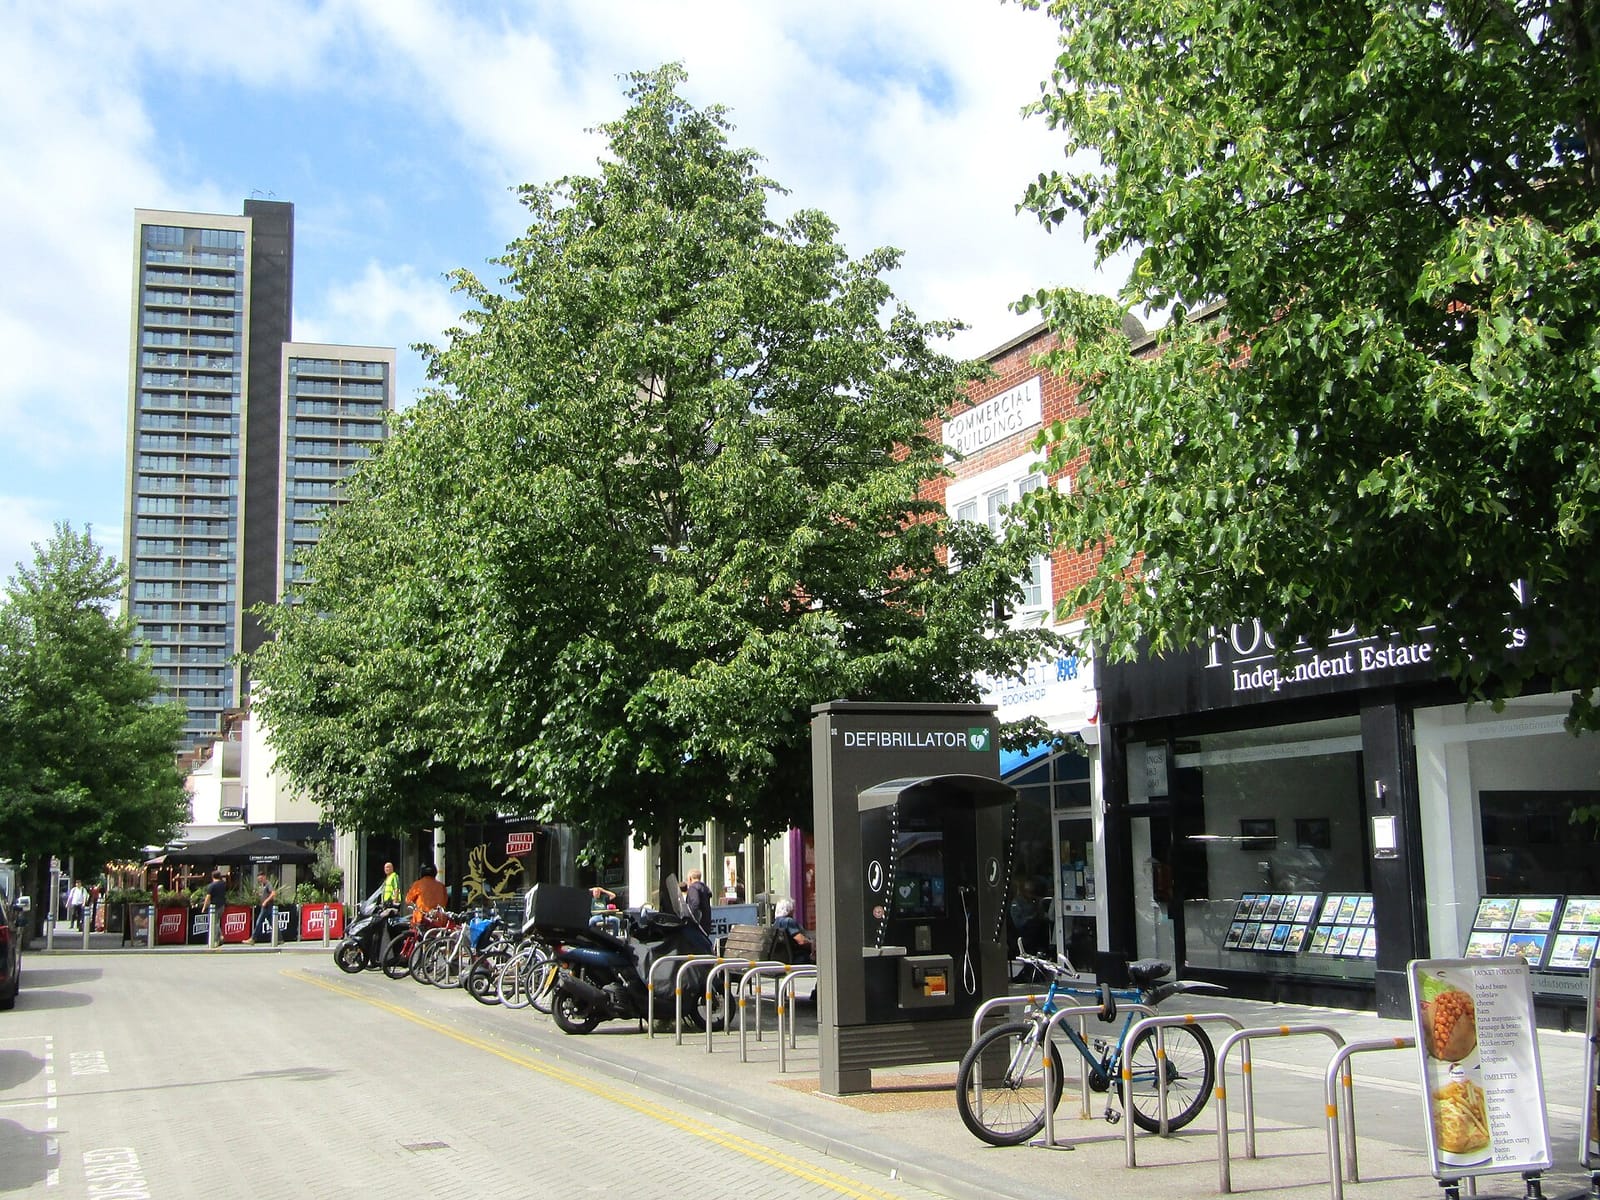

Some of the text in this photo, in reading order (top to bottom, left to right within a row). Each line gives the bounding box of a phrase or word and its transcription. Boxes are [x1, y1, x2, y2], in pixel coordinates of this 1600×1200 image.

[948, 385, 1031, 438] COMMERCIAL
[957, 410, 1023, 453] BUILDINGS
[1359, 642, 1431, 671] Estate
[1002, 688, 1046, 706] BOOKSHOP
[844, 732, 967, 747] DEFIBRILLATOR
